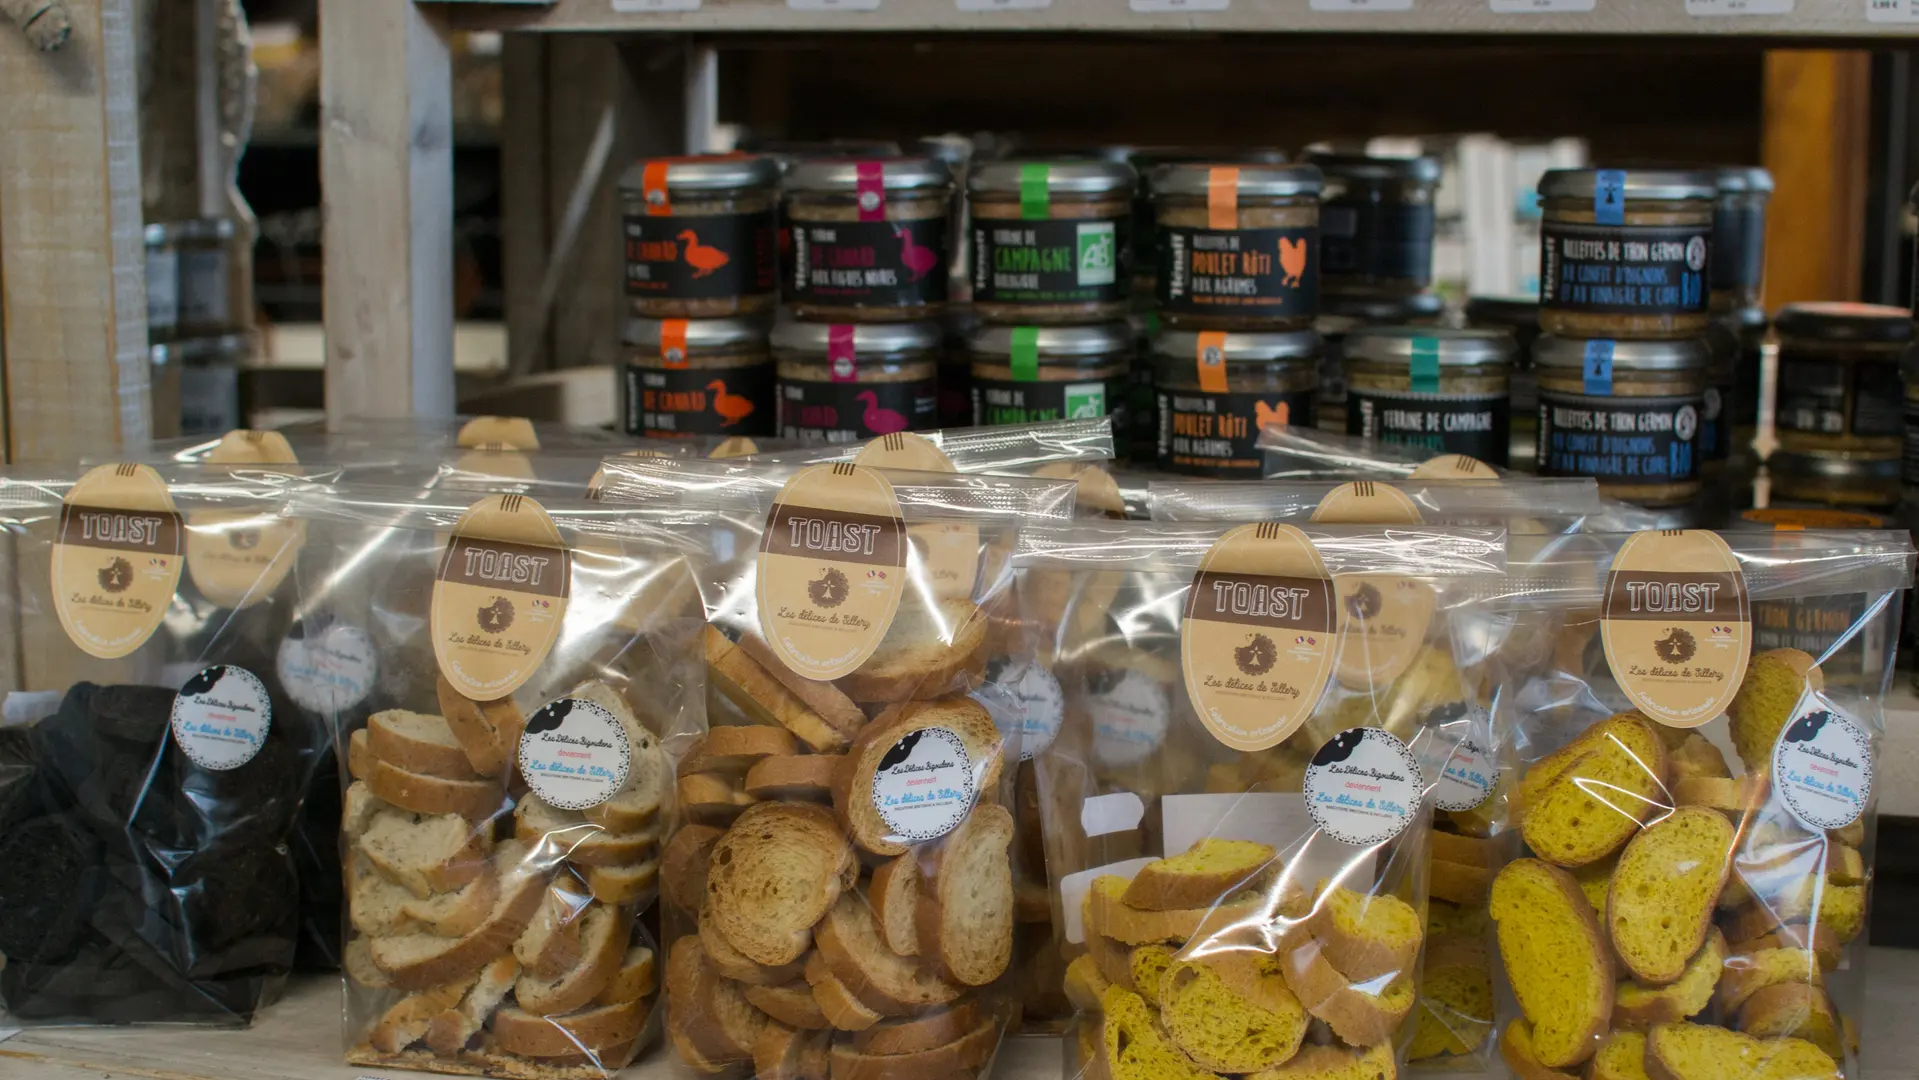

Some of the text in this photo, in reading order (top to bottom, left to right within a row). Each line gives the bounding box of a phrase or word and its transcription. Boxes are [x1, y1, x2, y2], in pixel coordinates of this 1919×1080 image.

[994, 246, 1072, 273] CAMPAGNE
[1192, 249, 1271, 276] POULET RÔTI
[1173, 412, 1248, 439] POULET RÔTI
[1383, 409, 1423, 431] TERRINE
[1426, 411, 1440, 432] DE
[1443, 411, 1492, 432] CAMPAGNE
[79, 511, 163, 546] TOAST
[788, 516, 881, 556] TOAST
[464, 546, 549, 585] TOAST
[1213, 580, 1310, 621] TOAST
[1626, 581, 1720, 613] TOAST
[777, 606, 796, 619] Les
[829, 612, 839, 624] de
[842, 614, 871, 631] Sillery
[1629, 665, 1646, 675] Les
[1681, 667, 1691, 677] de
[1695, 667, 1724, 682] Sillery
[1204, 675, 1222, 688] Les
[1256, 681, 1267, 692] de
[1270, 682, 1299, 699] Sillery
[541, 733, 555, 742] Les
[530, 760, 546, 770] Les
[577, 765, 586, 774] de
[891, 766, 904, 775] Les
[925, 760, 956, 772] Bigoudens
[1328, 764, 1344, 774] Les
[1369, 768, 1405, 782] Bigoudens
[884, 795, 899, 806] Les
[927, 790, 935, 800] de
[1316, 792, 1333, 802] Les
[1366, 799, 1376, 808] de
